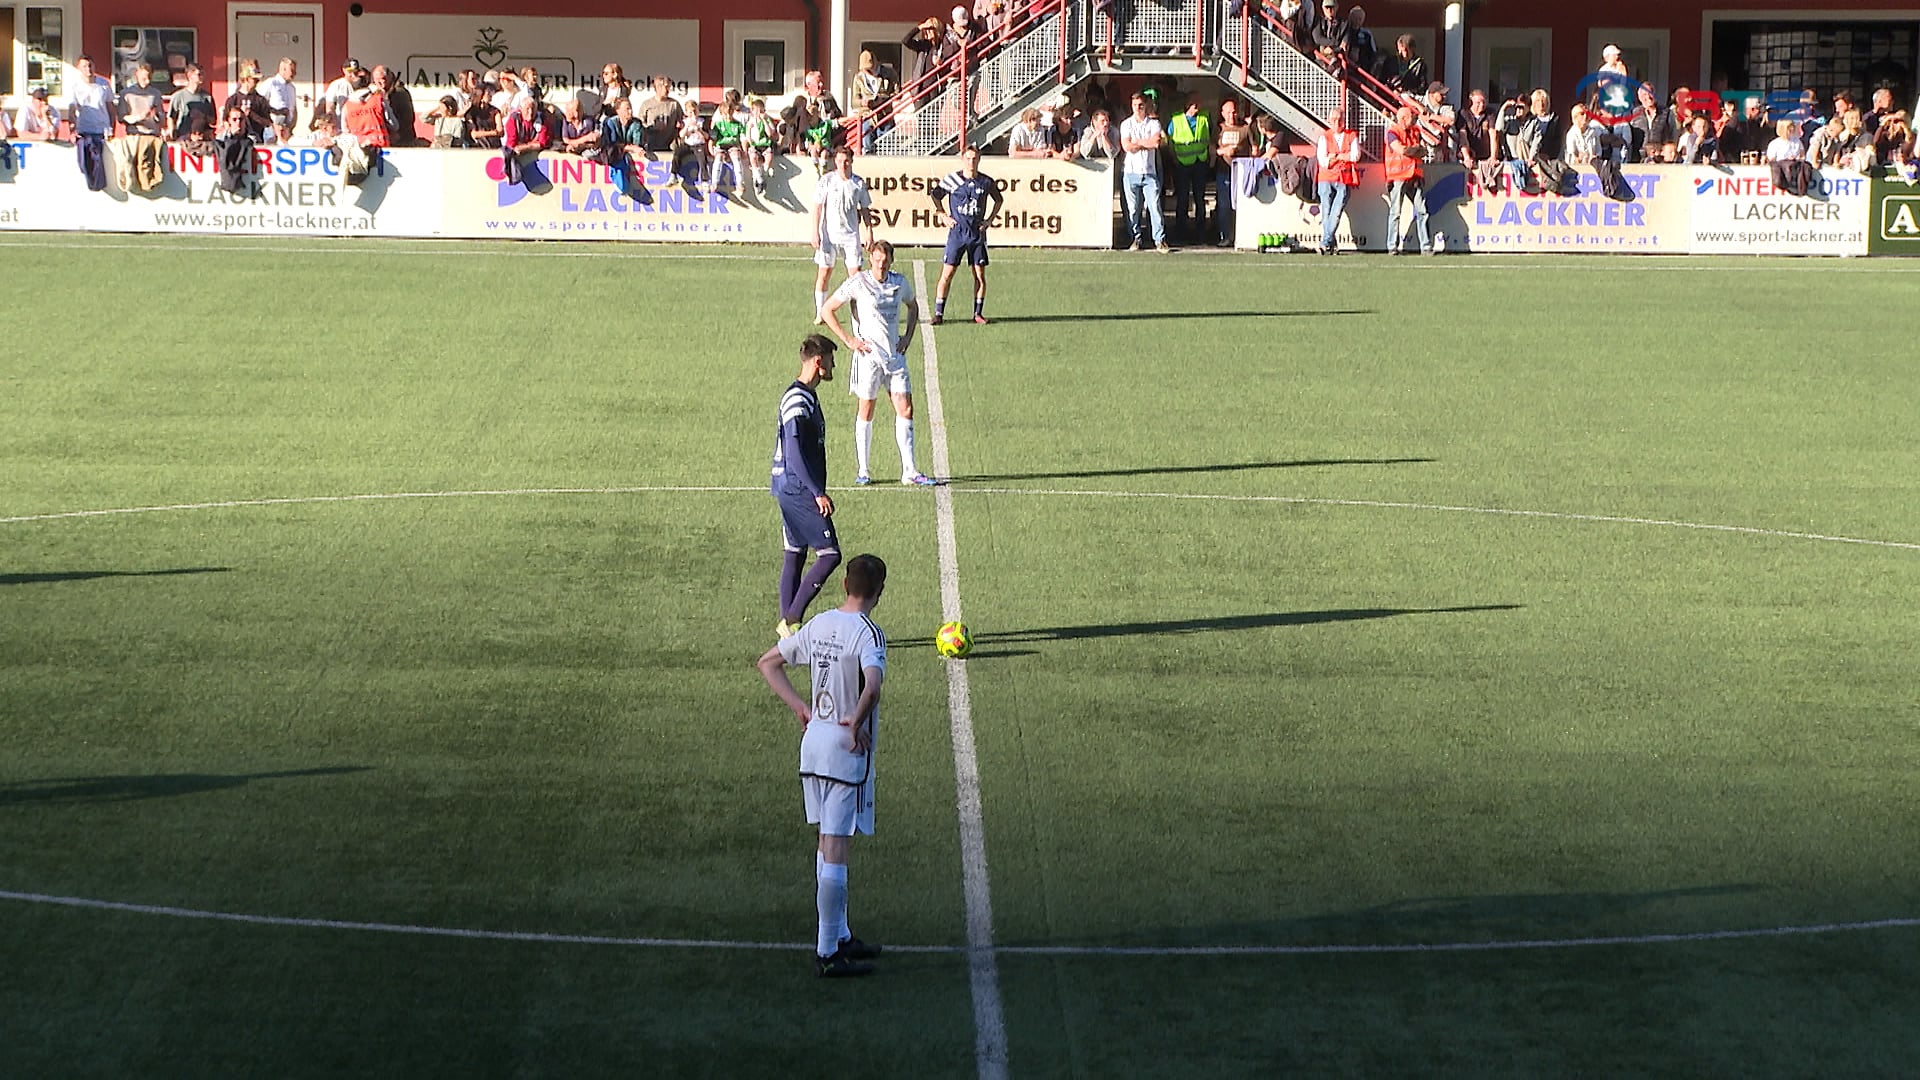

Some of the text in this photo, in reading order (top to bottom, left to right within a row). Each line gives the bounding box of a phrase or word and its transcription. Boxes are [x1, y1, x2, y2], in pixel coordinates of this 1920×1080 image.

[1029, 173, 1078, 193] des
[155, 211, 376, 231] www.sport-lackner.at
[1477, 201, 1645, 226] LACKNER
[1733, 203, 1841, 221] LACKNER
[485, 220, 743, 233] www.sport-lackner.at
[1695, 230, 1863, 246] www.sport-lackner.at
